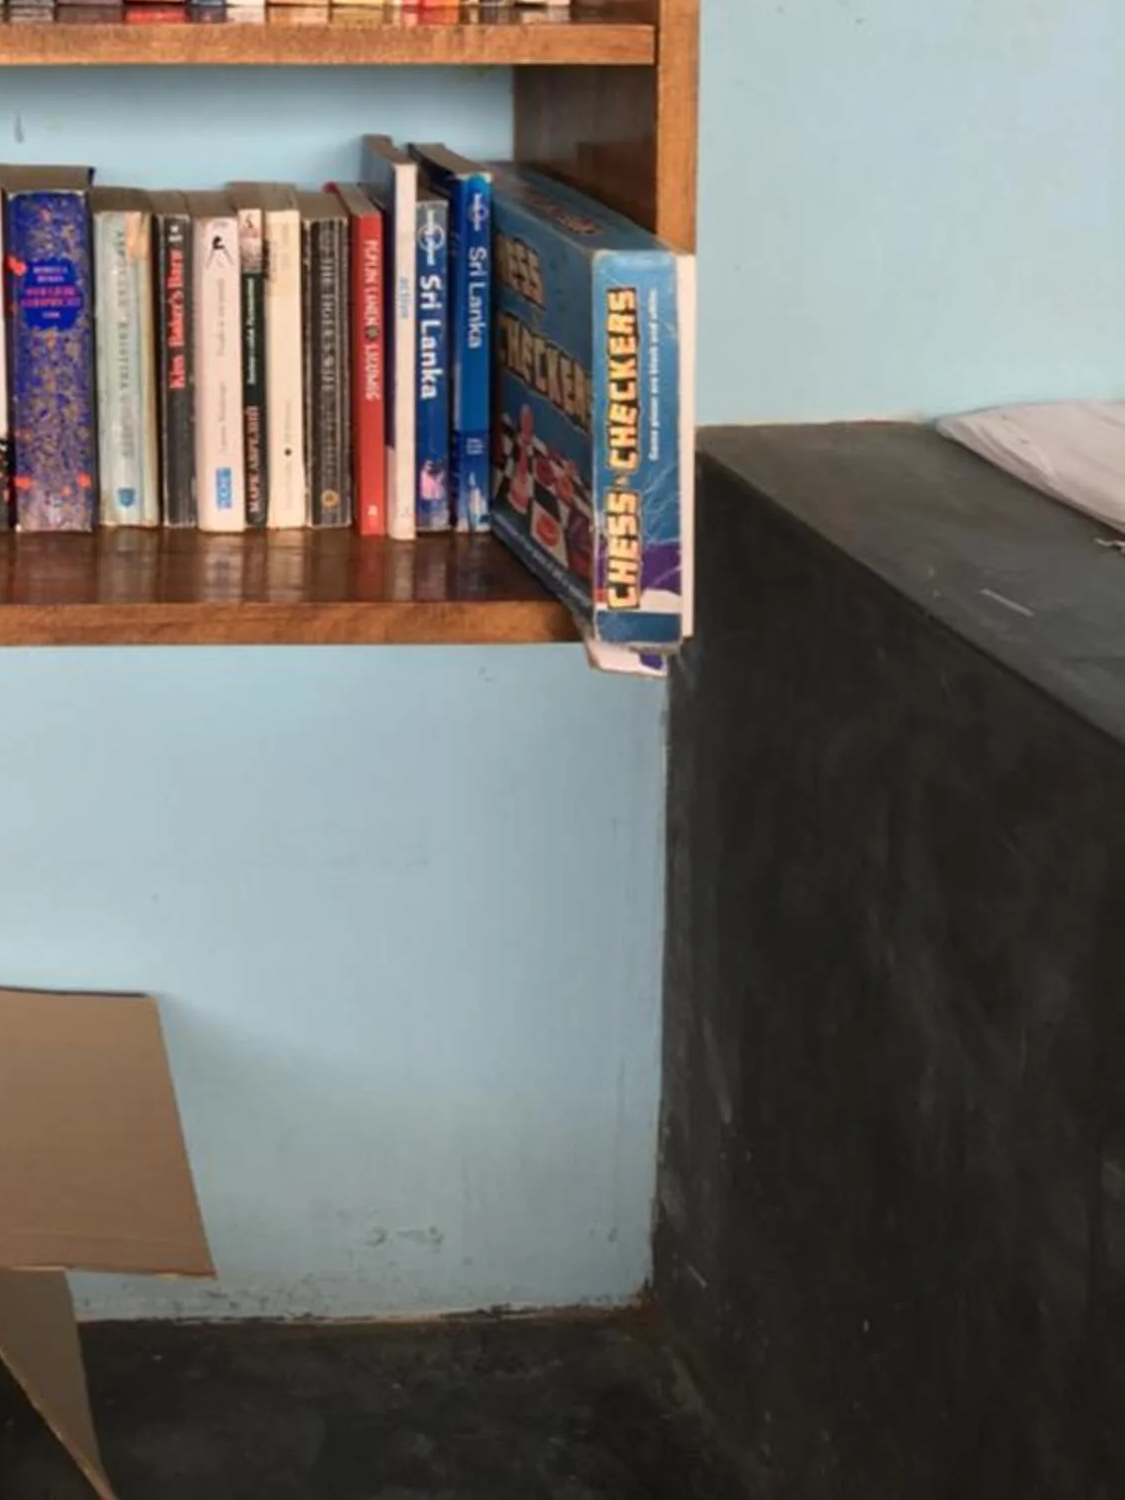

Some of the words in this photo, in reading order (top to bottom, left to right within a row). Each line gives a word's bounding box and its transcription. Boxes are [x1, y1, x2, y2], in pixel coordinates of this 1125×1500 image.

[420, 275, 443, 310] Sri
[469, 247, 487, 276] Sri
[469, 283, 487, 349] Lanka
[421, 319, 443, 399] Lanka
[604, 286, 640, 473] CHECKERS
[604, 487, 640, 610] CHESS
